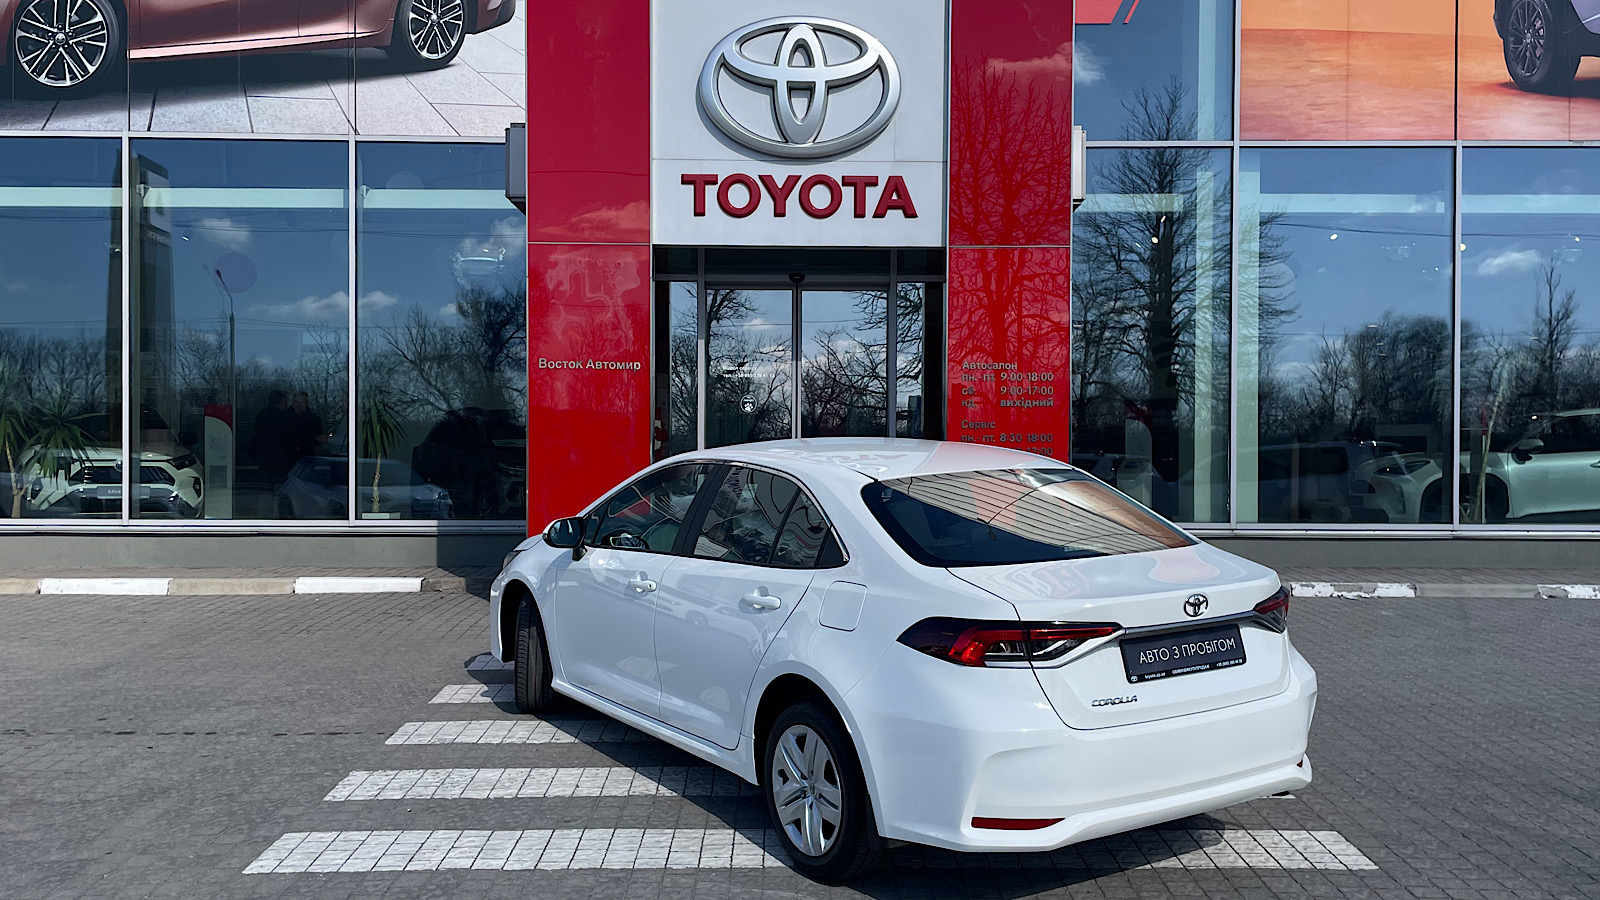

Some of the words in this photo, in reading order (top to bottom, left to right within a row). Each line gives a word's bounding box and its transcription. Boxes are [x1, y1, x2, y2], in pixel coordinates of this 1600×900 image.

[681, 173, 918, 219] TOYOTA
[538, 358, 583, 369] Восток
[585, 358, 641, 372] Автомир
[962, 361, 1018, 370] Автосалон
[1000, 397, 1054, 408] вихідний
[961, 419, 996, 430] Сервіс
[1138, 647, 1170, 664] АВТО
[1181, 638, 1236, 657] ПРОБІГОМ
[1091, 695, 1138, 707] COROLLA
